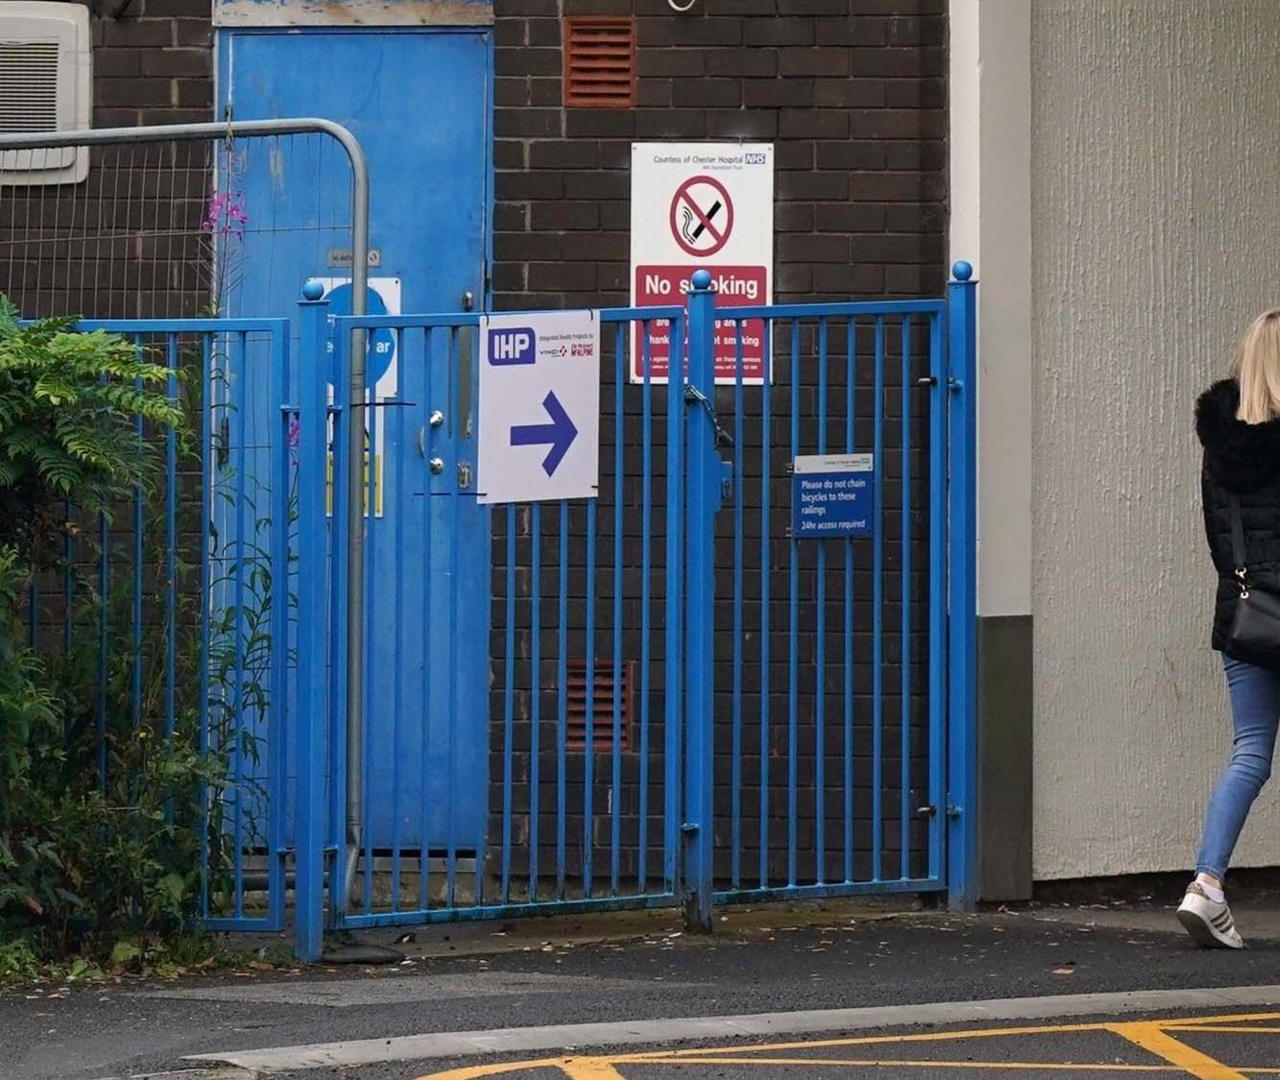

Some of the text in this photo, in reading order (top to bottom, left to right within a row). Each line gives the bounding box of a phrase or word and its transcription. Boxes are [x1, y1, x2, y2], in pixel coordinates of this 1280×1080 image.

[653, 153, 766, 165] Countess of Chester Hospital NHS
[645, 275, 758, 299] No soking
[723, 319, 747, 327] ares
[494, 333, 530, 359] IHP
[648, 335, 670, 345] hank
[723, 335, 759, 347] smking
[801, 479, 866, 489] Please do not chain
[801, 492, 827, 503] bicycles
[837, 492, 856, 500] these
[801, 505, 826, 516] railings
[801, 520, 866, 531] 24hr access required
